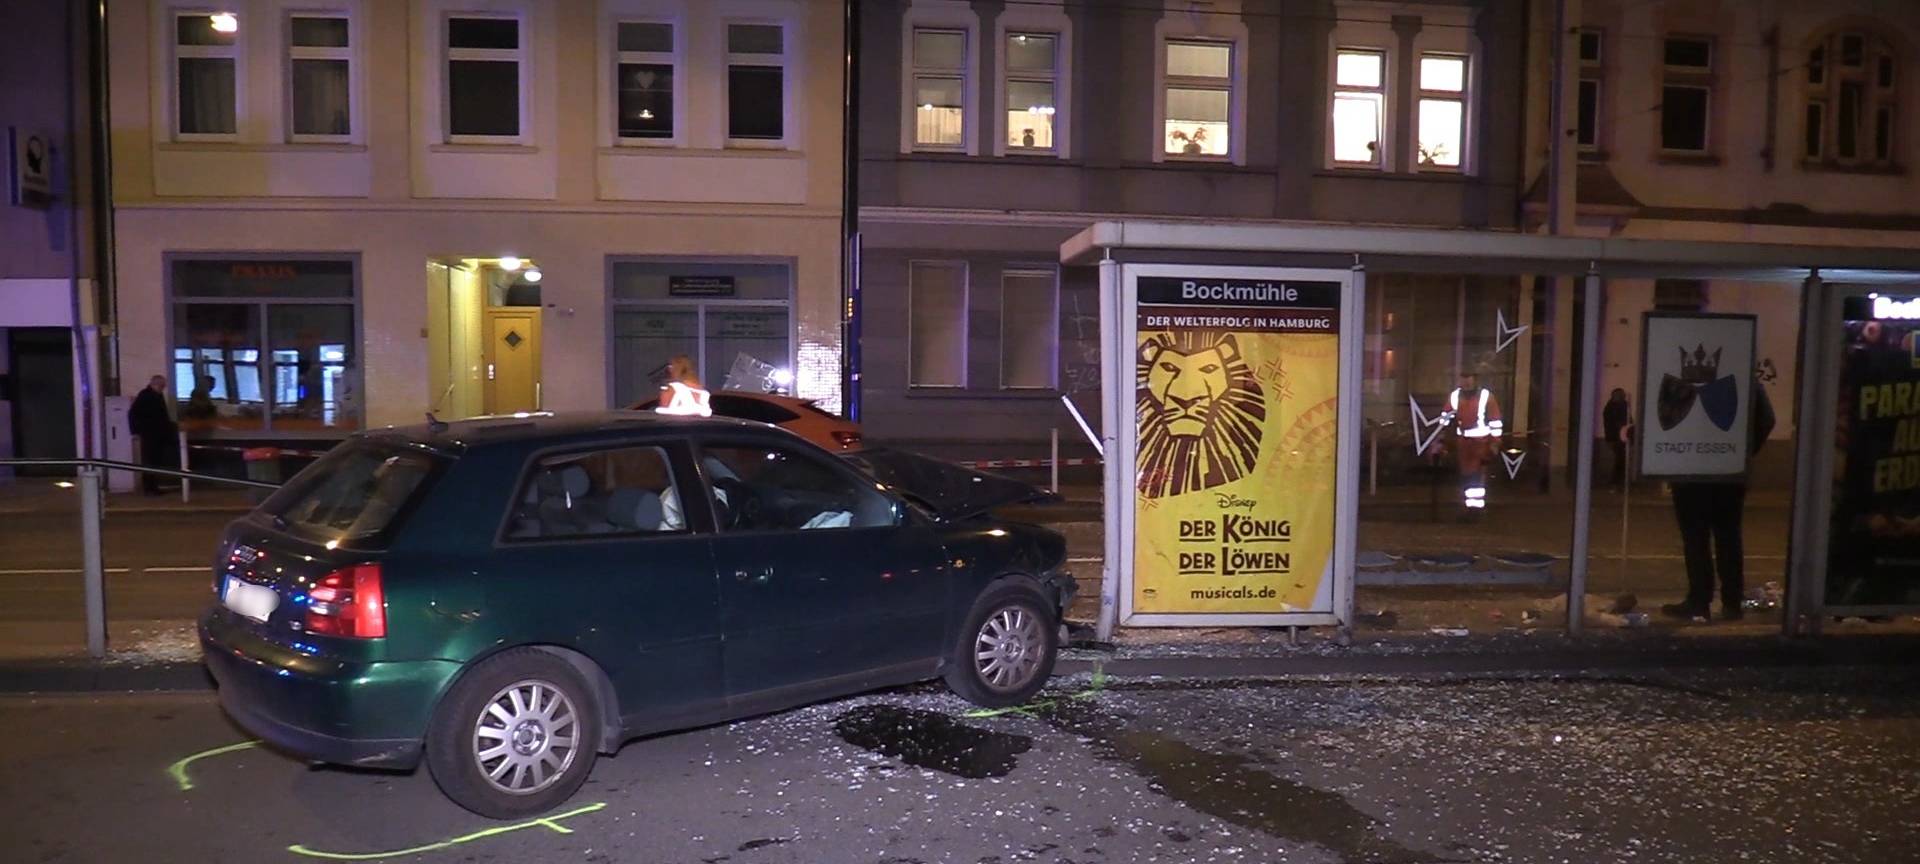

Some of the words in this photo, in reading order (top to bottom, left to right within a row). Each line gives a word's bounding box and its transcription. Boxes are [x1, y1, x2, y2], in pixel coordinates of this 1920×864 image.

[1181, 281, 1298, 301] Bockmühle
[1146, 316, 1170, 326] DER
[1174, 316, 1251, 327] WELTERFOLG
[1253, 318, 1266, 328] IN
[1269, 318, 1330, 328] HAMBURG
[1655, 442, 1692, 454] STADT
[1696, 442, 1737, 454] ESSEN
[1179, 520, 1216, 537] DER
[1222, 514, 1291, 544] KÖNIG
[1179, 553, 1216, 569] DER
[1222, 547, 1290, 576] LÖWEN
[1190, 586, 1277, 600] musicals.de
